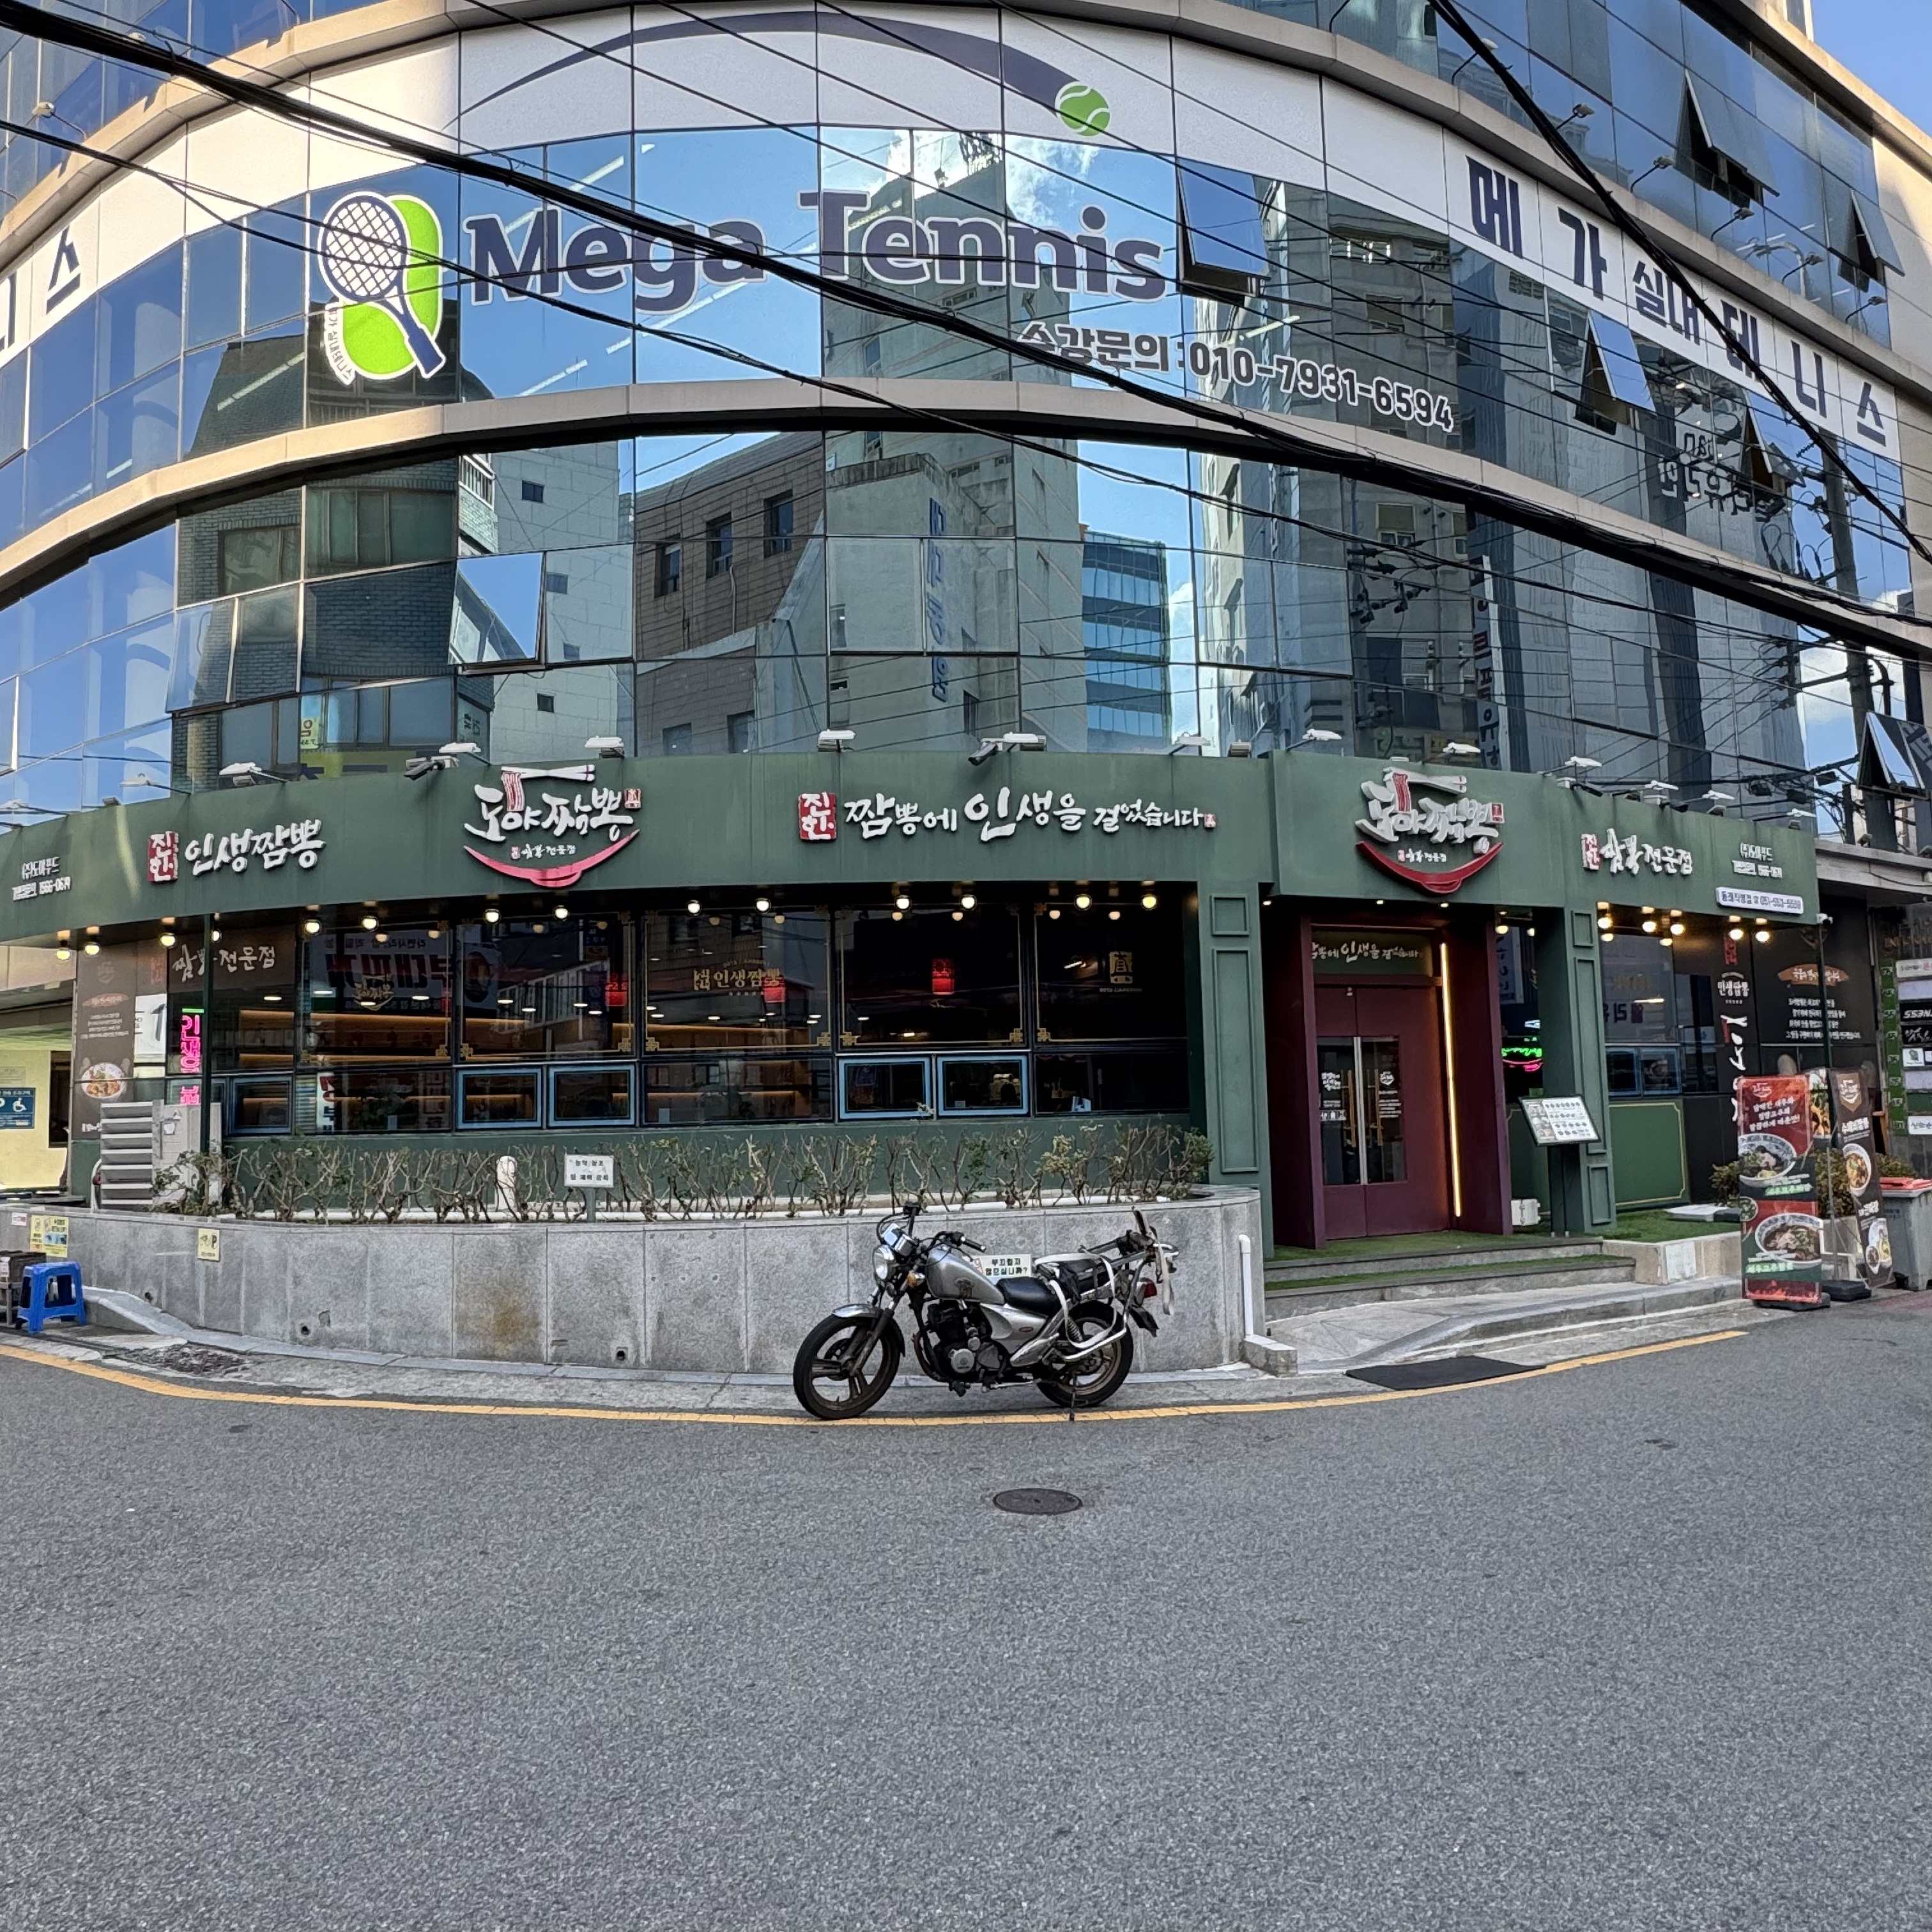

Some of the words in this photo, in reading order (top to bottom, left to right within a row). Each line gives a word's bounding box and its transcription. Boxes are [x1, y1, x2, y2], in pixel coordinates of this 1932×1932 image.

[464, 207, 765, 313] Mega
[800, 190, 1168, 303] Tennis
[1466, 155, 1607, 301] 메가
[1632, 261, 1701, 346] 실내
[1721, 300, 1887, 447] 테니스
[1190, 341, 1453, 433] 010-7931-6594
[844, 793, 957, 839] 짬뽕에
[963, 786, 1087, 842] 인생을
[1091, 799, 1204, 833] 걸었습니다
[185, 819, 325, 877] 인생짬뽕
[1641, 843, 1693, 875] 전문점
[219, 946, 276, 973] 전문점
[713, 968, 781, 988] 인생짬뽕
[1340, 940, 1380, 963] 인생을
